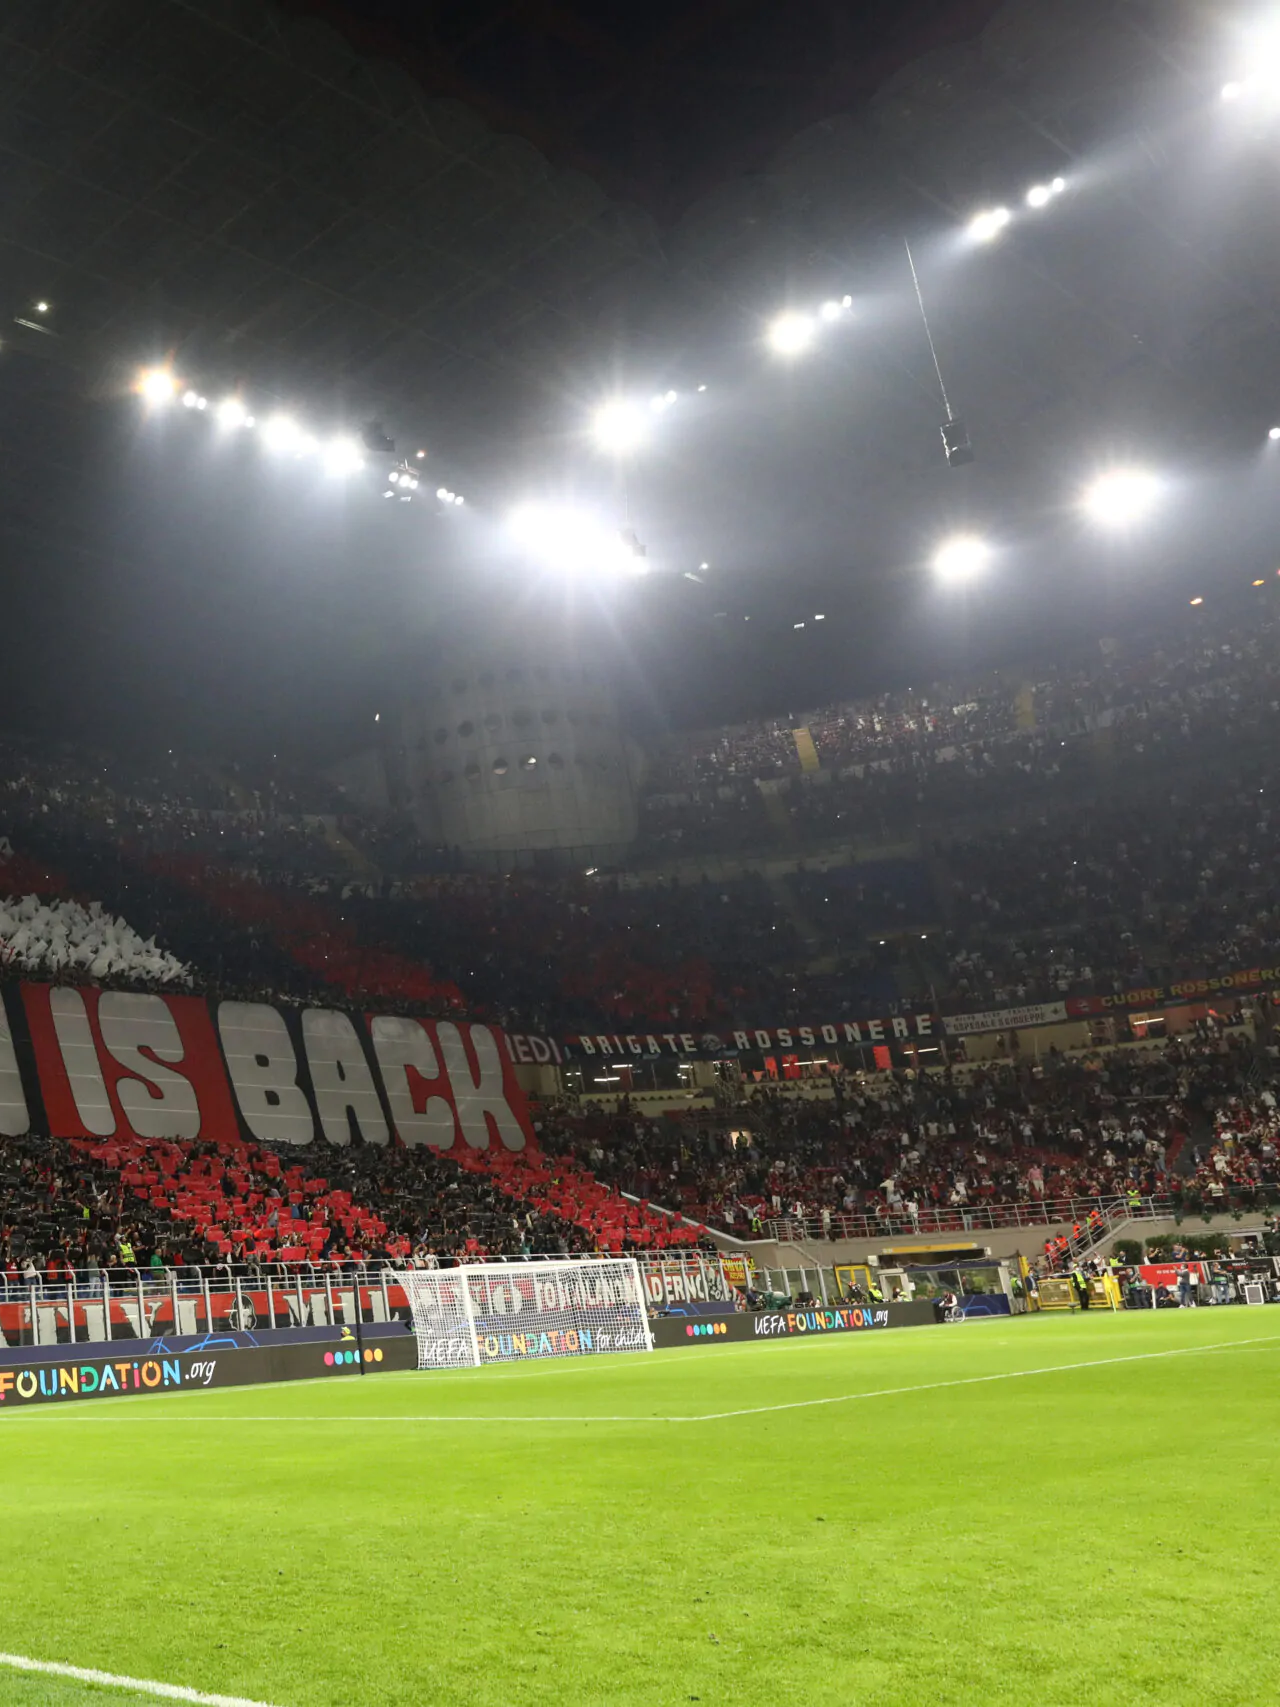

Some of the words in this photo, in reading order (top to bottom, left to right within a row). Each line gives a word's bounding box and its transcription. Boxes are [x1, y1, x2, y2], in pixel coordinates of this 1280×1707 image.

[1101, 987, 1166, 1008] CUORE
[578, 1033, 698, 1056] BRIGATE
[733, 1013, 933, 1050] ROSSONERE
[50, 986, 201, 1140] IS
[217, 1001, 526, 1152] BACK
[755, 1315, 787, 1335] UEFA
[423, 1339, 468, 1362] UEFA
[595, 1327, 611, 1352] for
[614, 1326, 656, 1347] childrn
